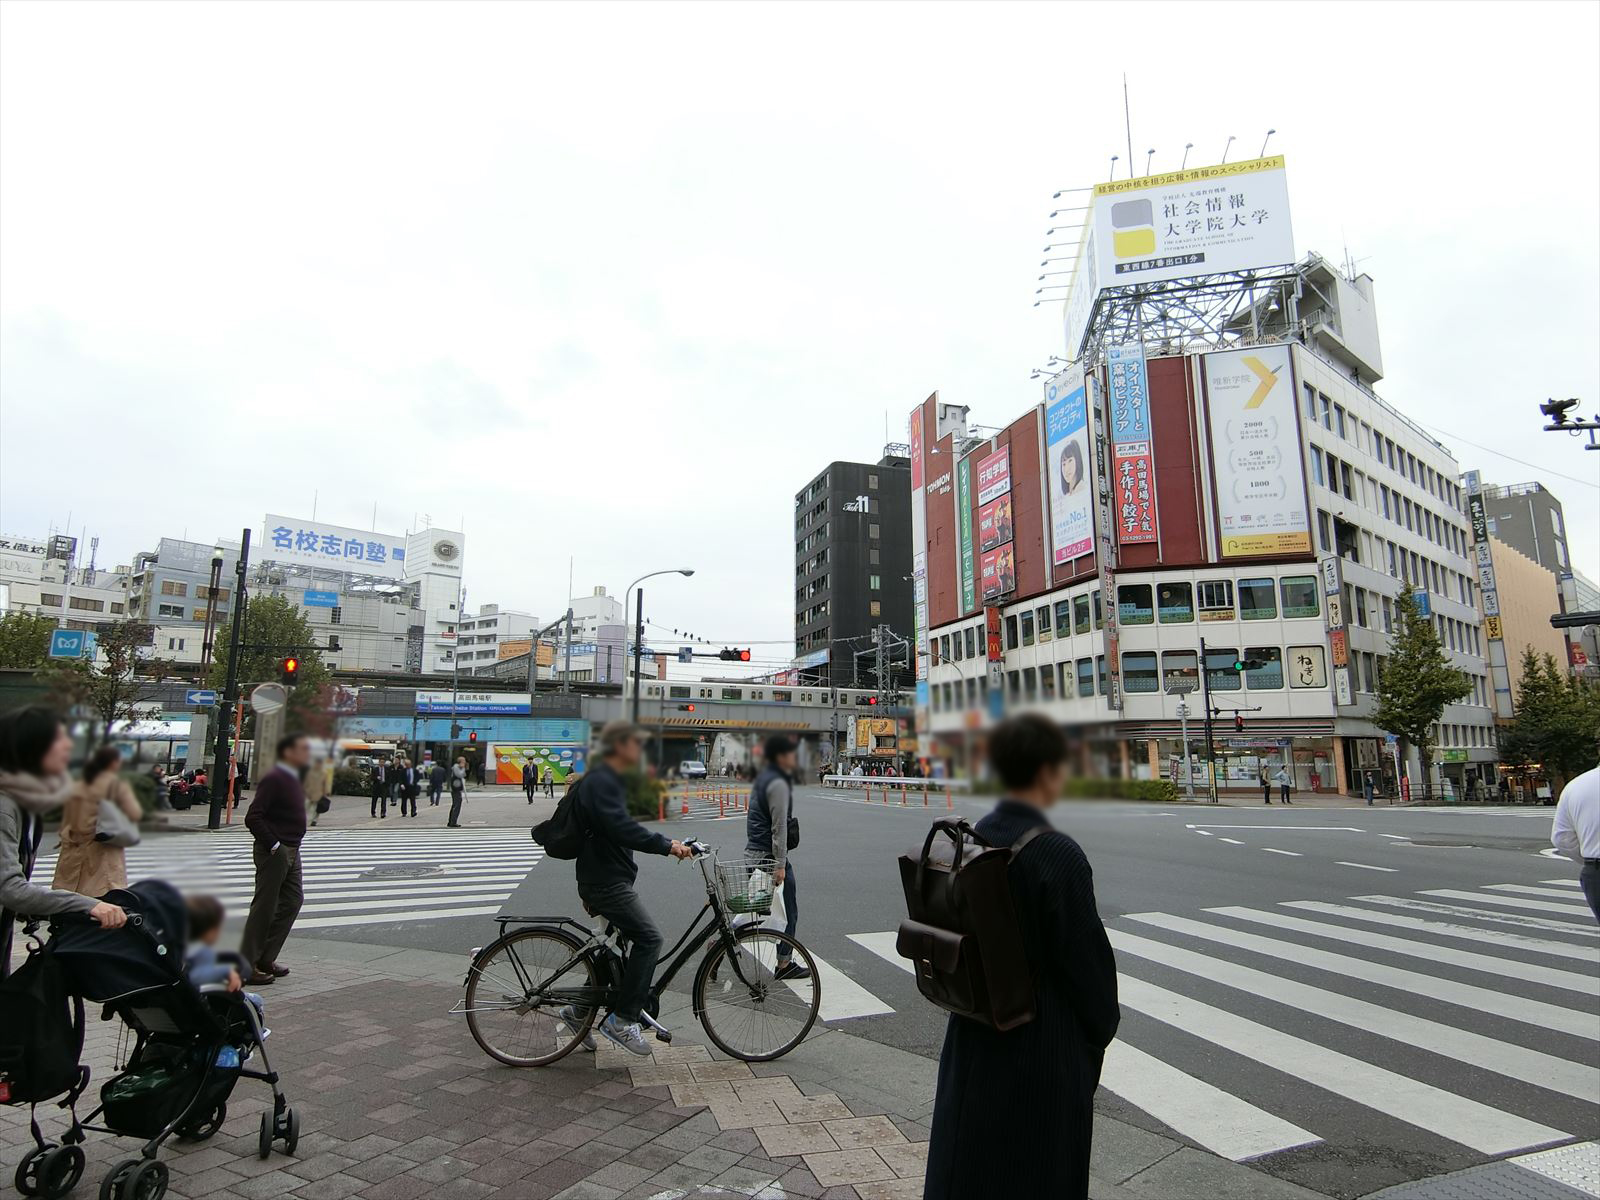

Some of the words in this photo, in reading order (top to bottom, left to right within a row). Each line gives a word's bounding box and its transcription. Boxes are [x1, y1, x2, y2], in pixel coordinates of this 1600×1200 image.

[1163, 193, 1245, 218] 社会情報
[1164, 209, 1269, 238] 大学院大学
[1050, 396, 1082, 424] コンタクトの
[1128, 361, 1144, 431] オイスターと
[1050, 410, 1082, 437] アイシティ
[1120, 460, 1138, 533] 手作り餃子
[1136, 459, 1152, 532] 高田馬場で人気
[1070, 507, 1087, 524] No.1
[271, 526, 388, 563] 名校志向塾
[1330, 602, 1339, 625] ねぎし
[1297, 654, 1314, 686] ねぎし
